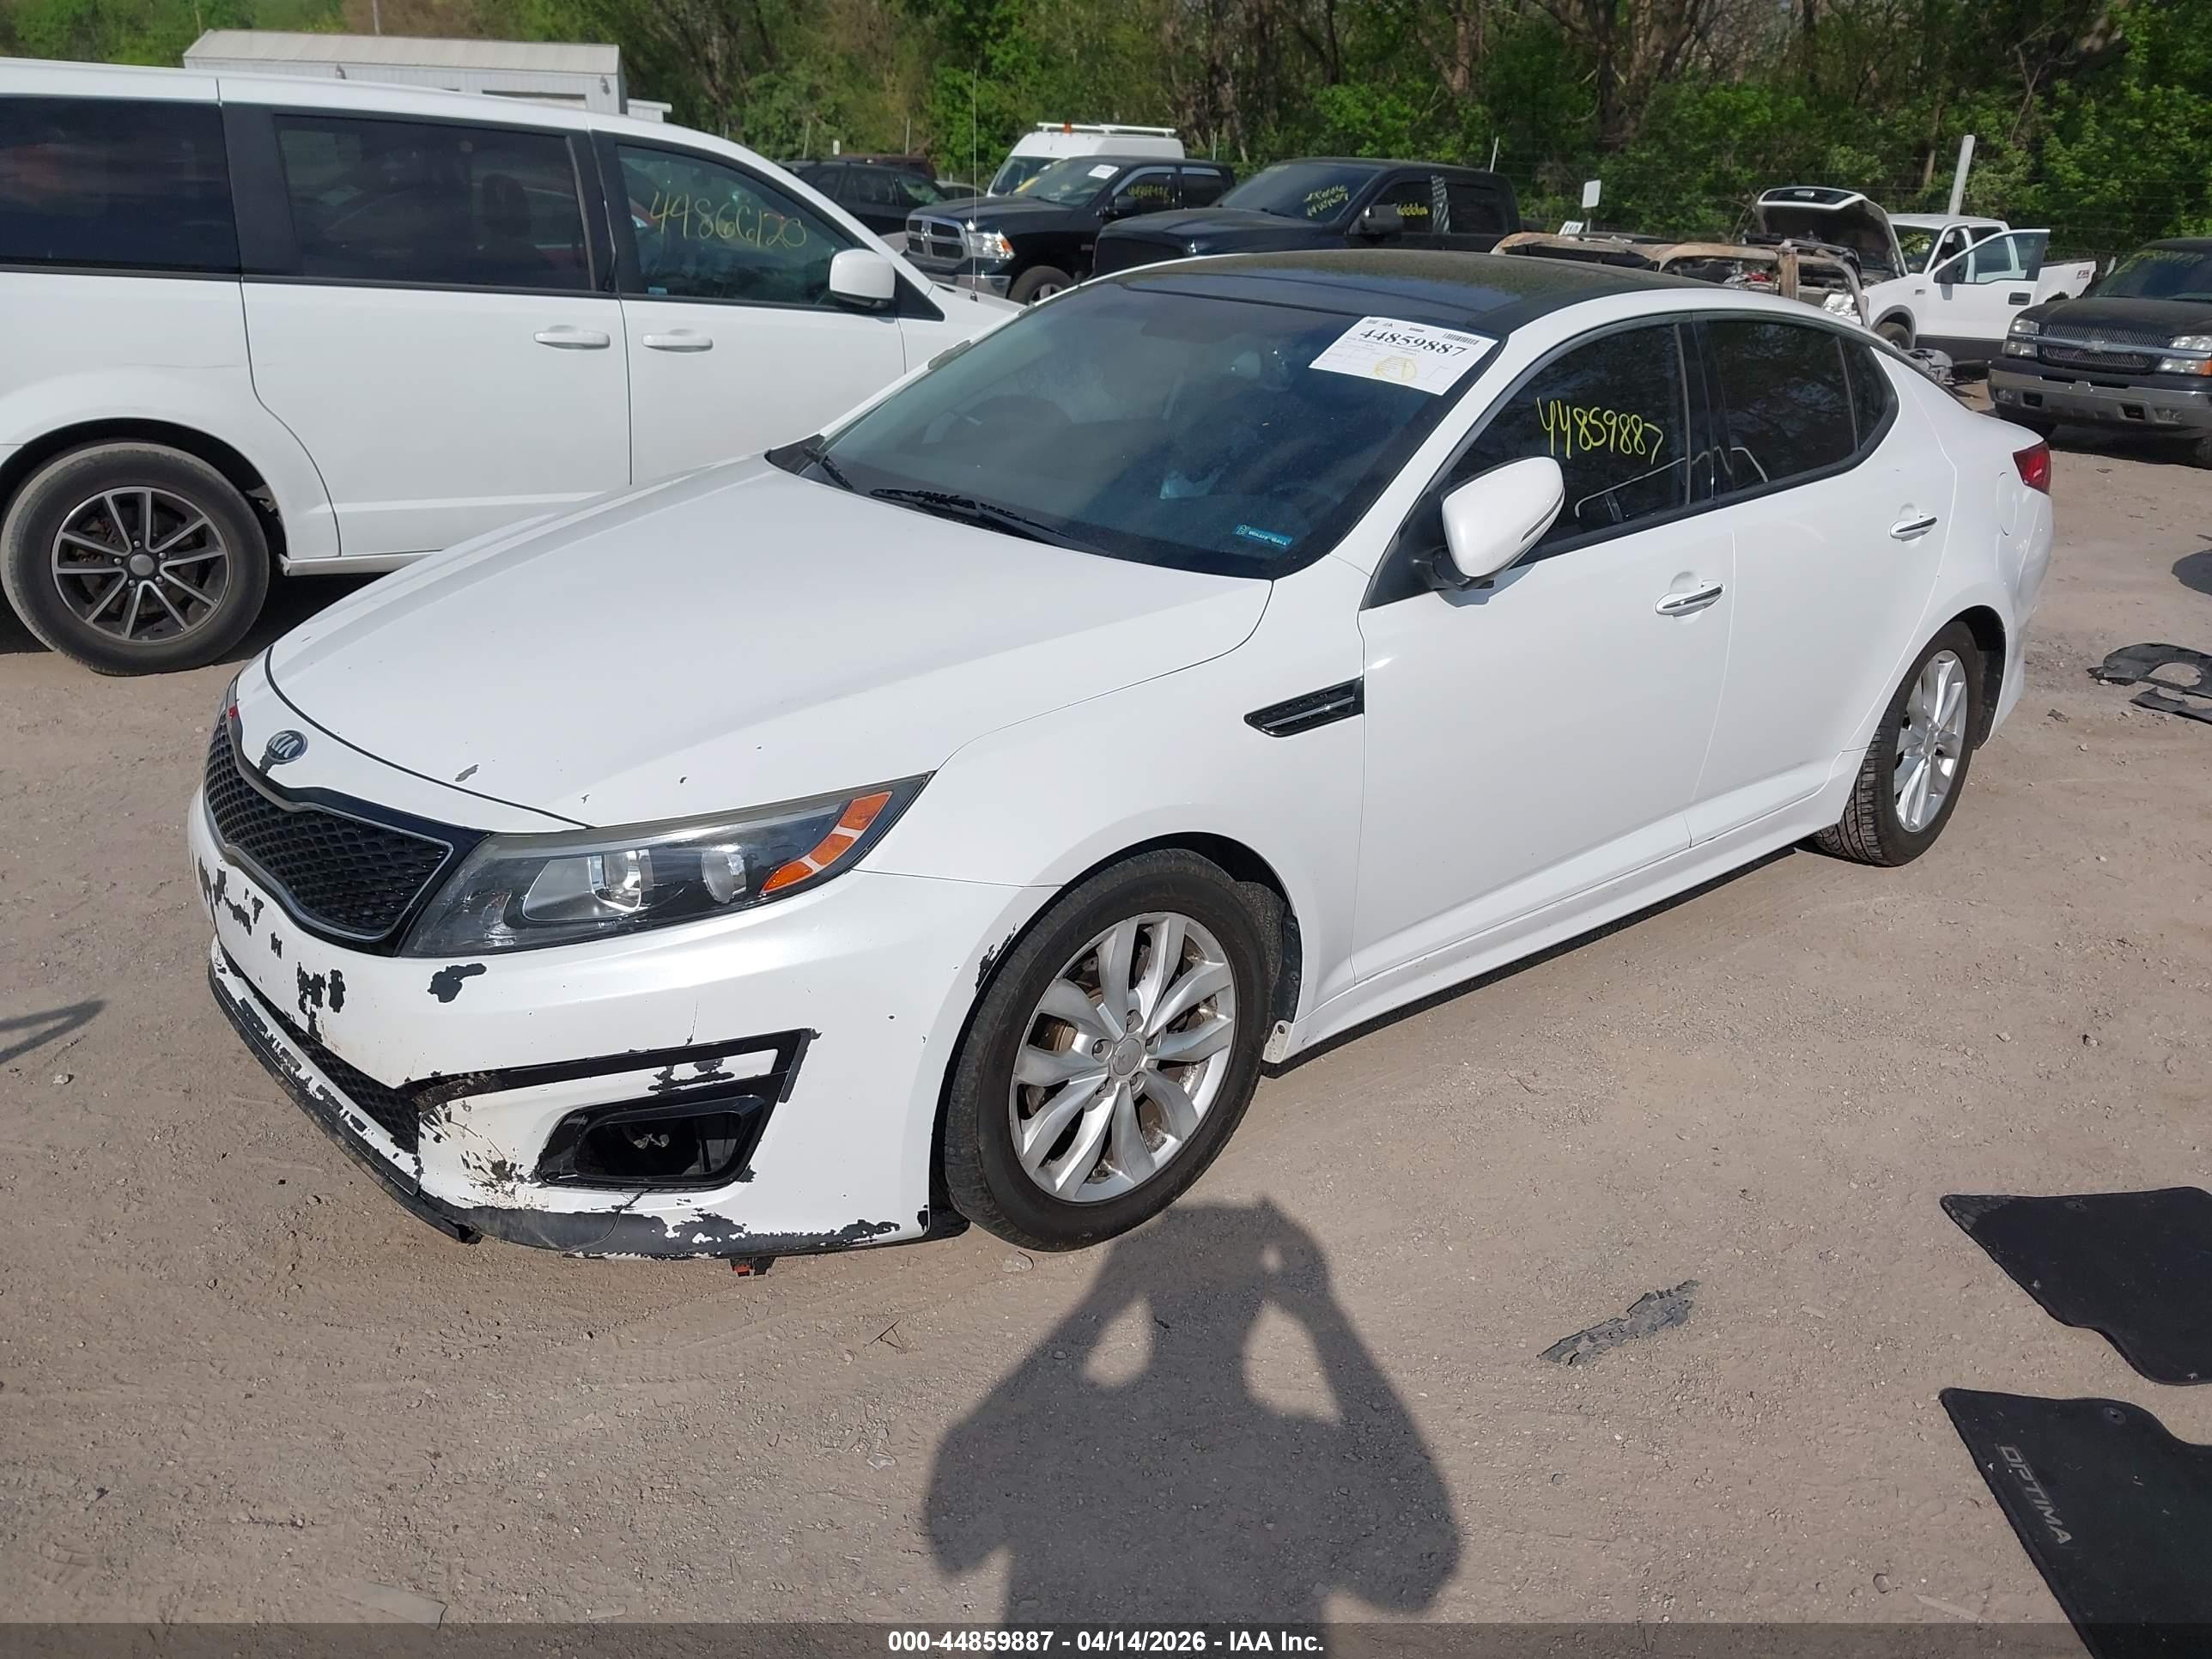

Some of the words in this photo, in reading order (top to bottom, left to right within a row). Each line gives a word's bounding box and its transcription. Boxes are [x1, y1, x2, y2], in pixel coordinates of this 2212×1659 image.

[650, 191, 807, 248] 44866120
[1359, 328, 1470, 357] 44859887
[1536, 397, 1664, 465] 44859887
[268, 732, 301, 759] KIA
[1999, 1445, 2073, 1544] OPTIMA
